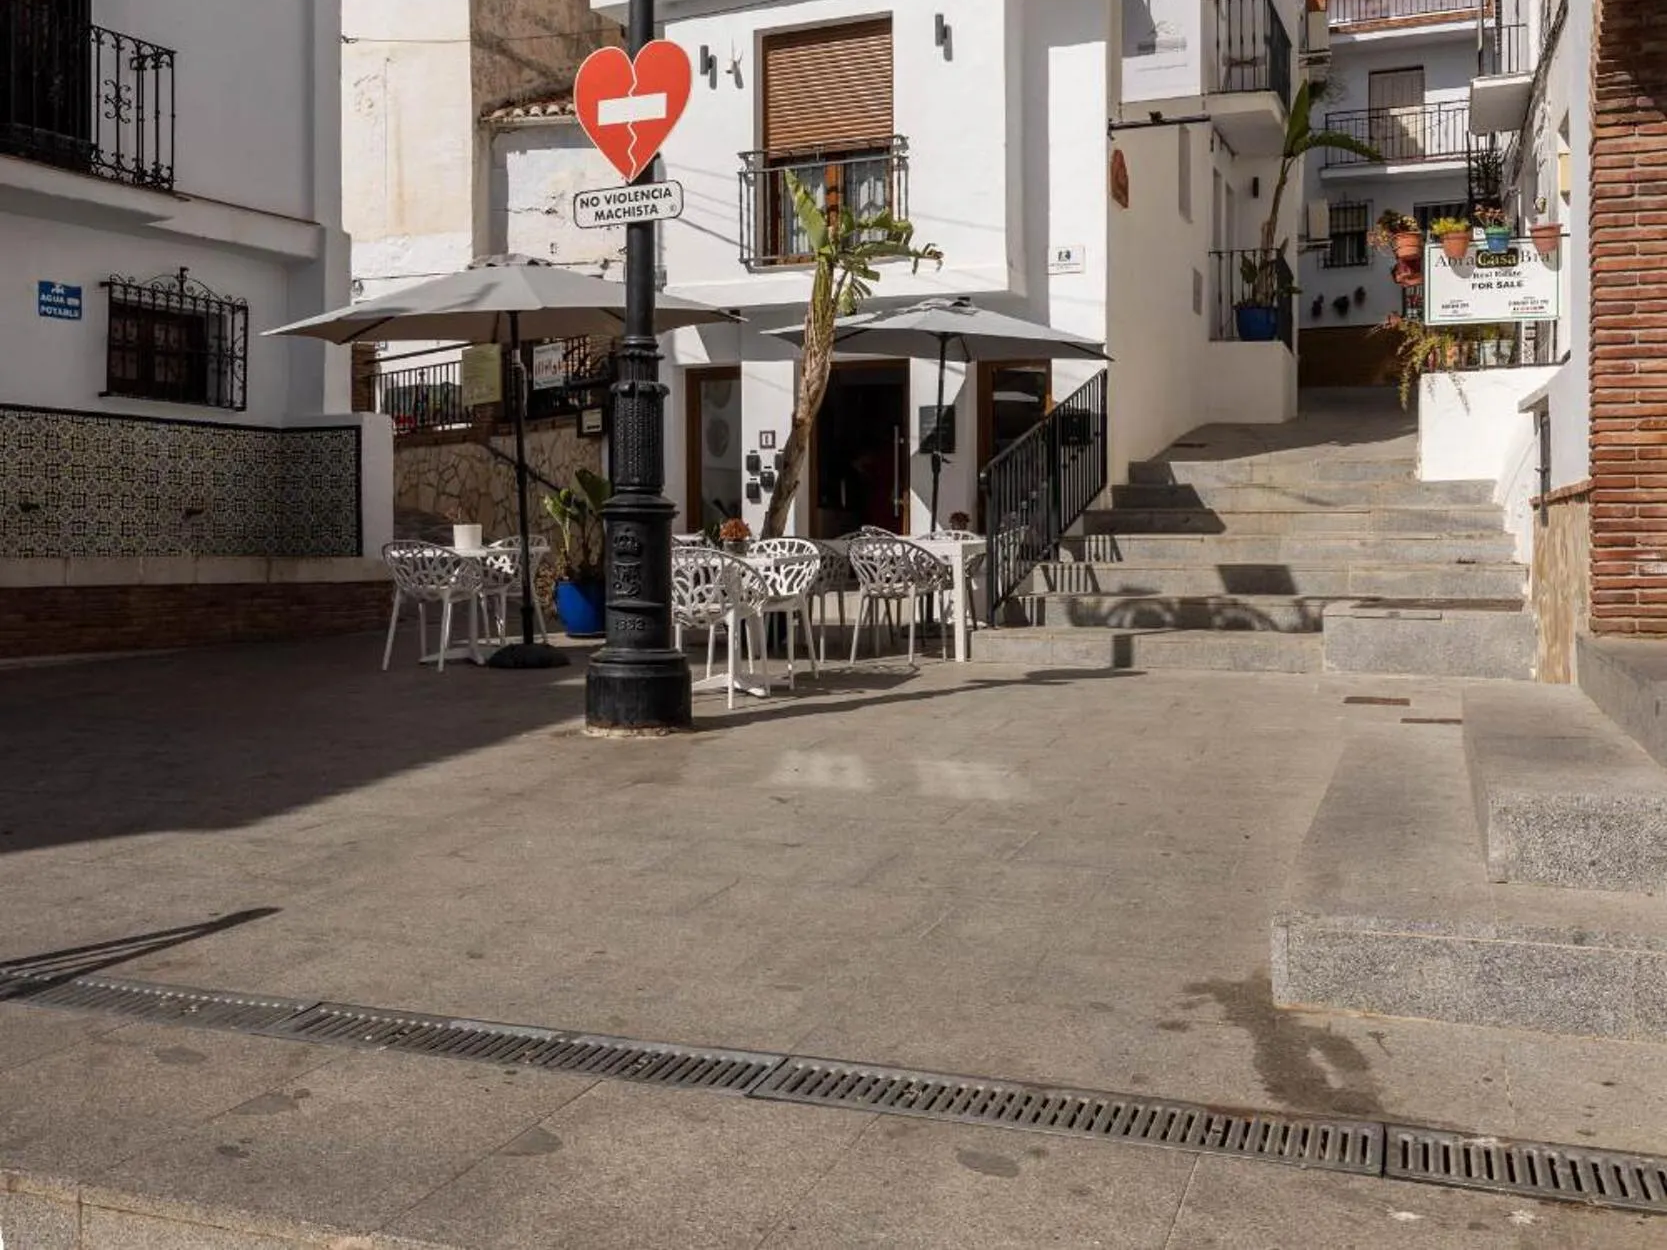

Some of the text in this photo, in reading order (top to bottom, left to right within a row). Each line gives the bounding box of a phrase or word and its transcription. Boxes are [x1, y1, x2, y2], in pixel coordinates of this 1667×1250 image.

[580, 187, 672, 209] NO VIOLENCIA
[594, 203, 659, 222] MACHISTA
[1471, 280, 1524, 290] FOR SALE
[40, 293, 65, 304] AGUA
[40, 305, 79, 318] POTABLE
